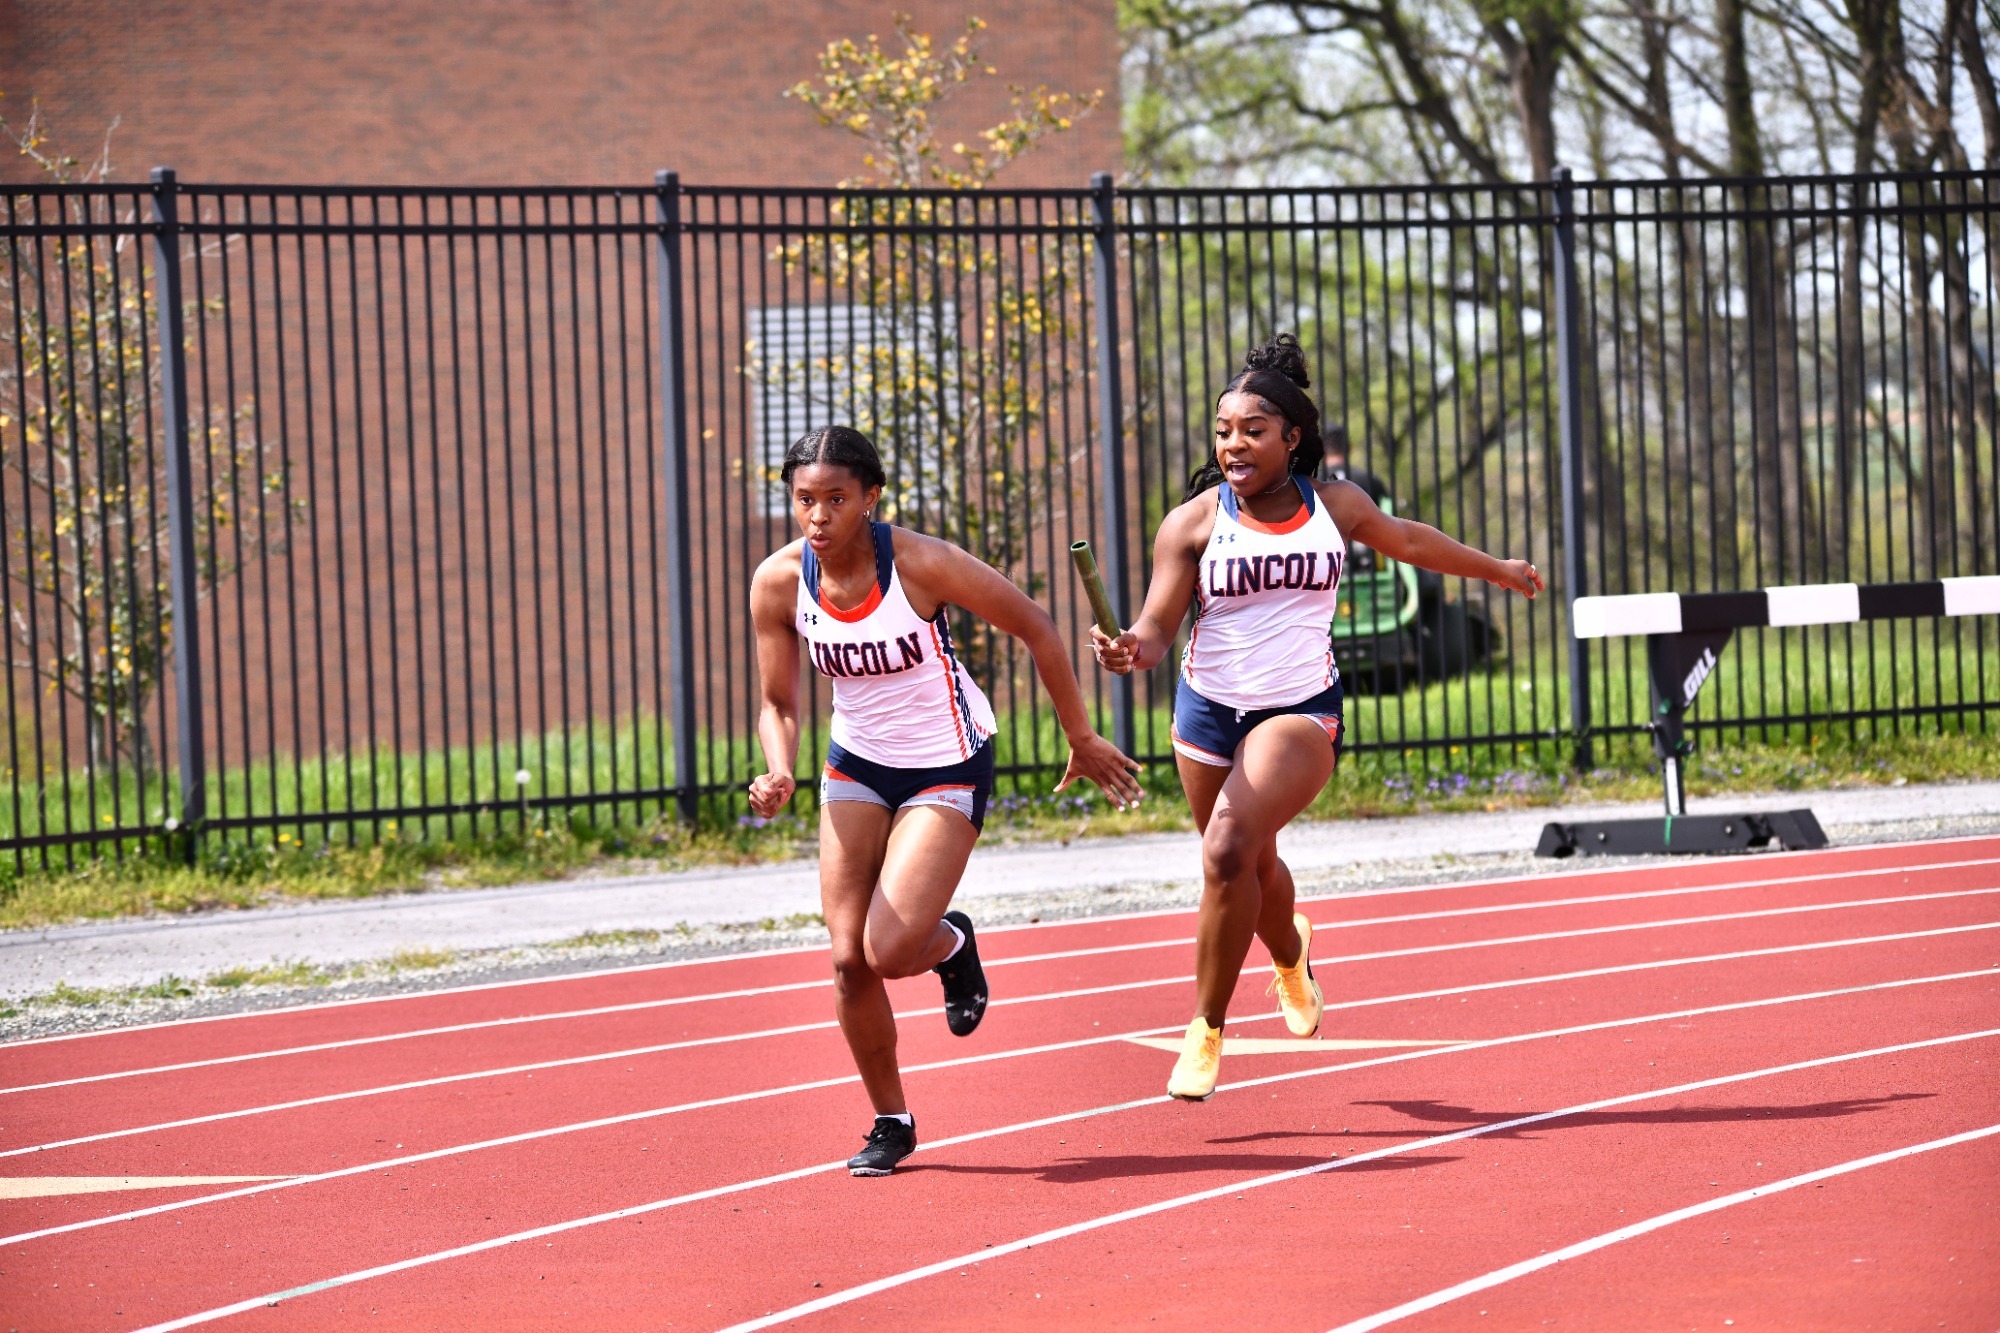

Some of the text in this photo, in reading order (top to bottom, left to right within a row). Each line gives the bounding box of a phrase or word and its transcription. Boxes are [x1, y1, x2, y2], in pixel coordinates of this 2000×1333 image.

[1209, 551, 1341, 597] LINCOLN
[804, 631, 924, 677] INCOLN
[1683, 647, 1717, 703] GILL
